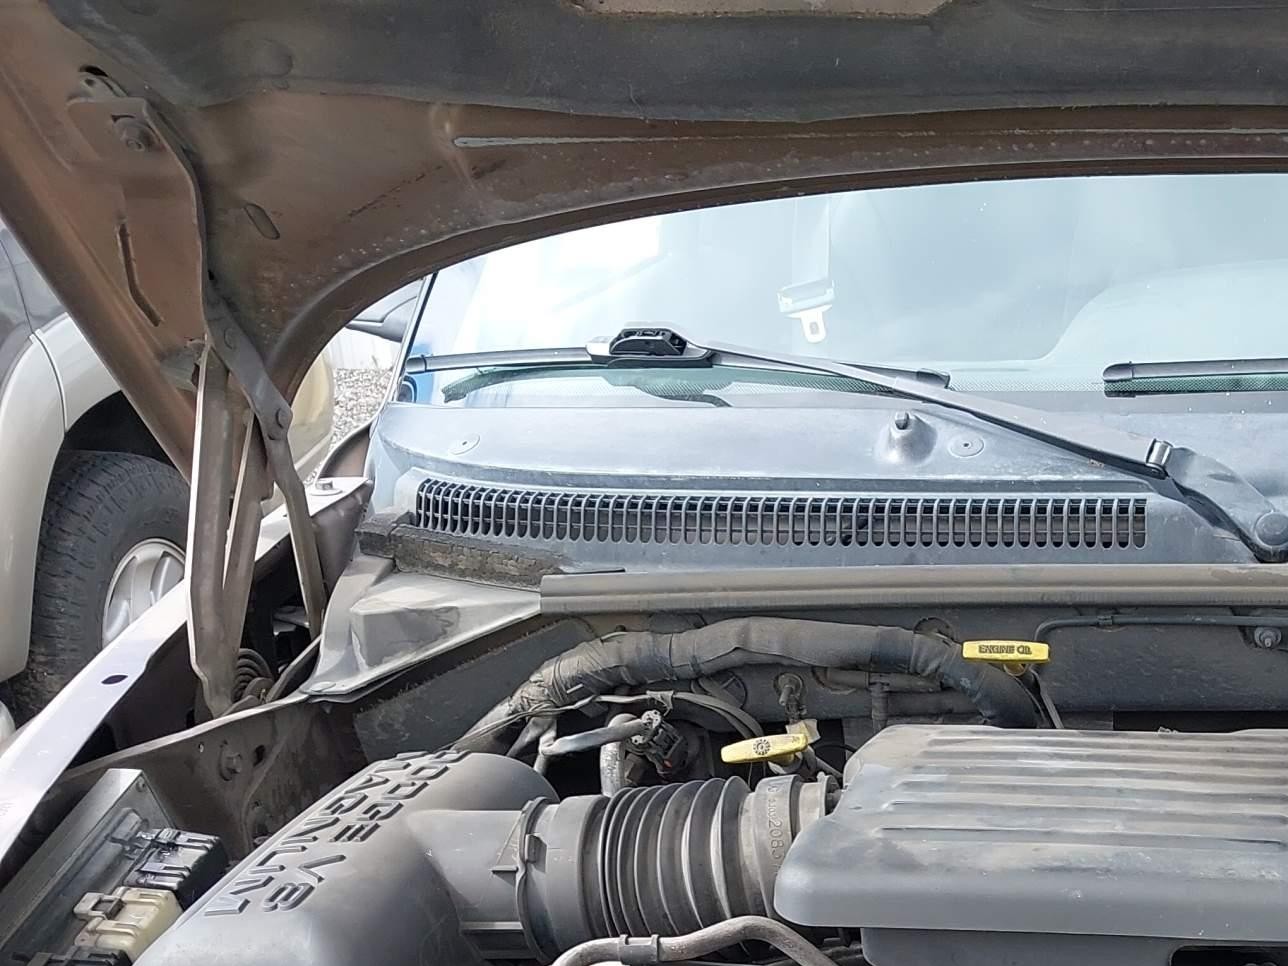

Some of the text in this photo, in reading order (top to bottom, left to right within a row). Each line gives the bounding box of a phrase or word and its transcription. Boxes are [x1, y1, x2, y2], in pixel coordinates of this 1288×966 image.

[978, 644, 1015, 654] ENGINE
[262, 749, 471, 912] DODGE V8
